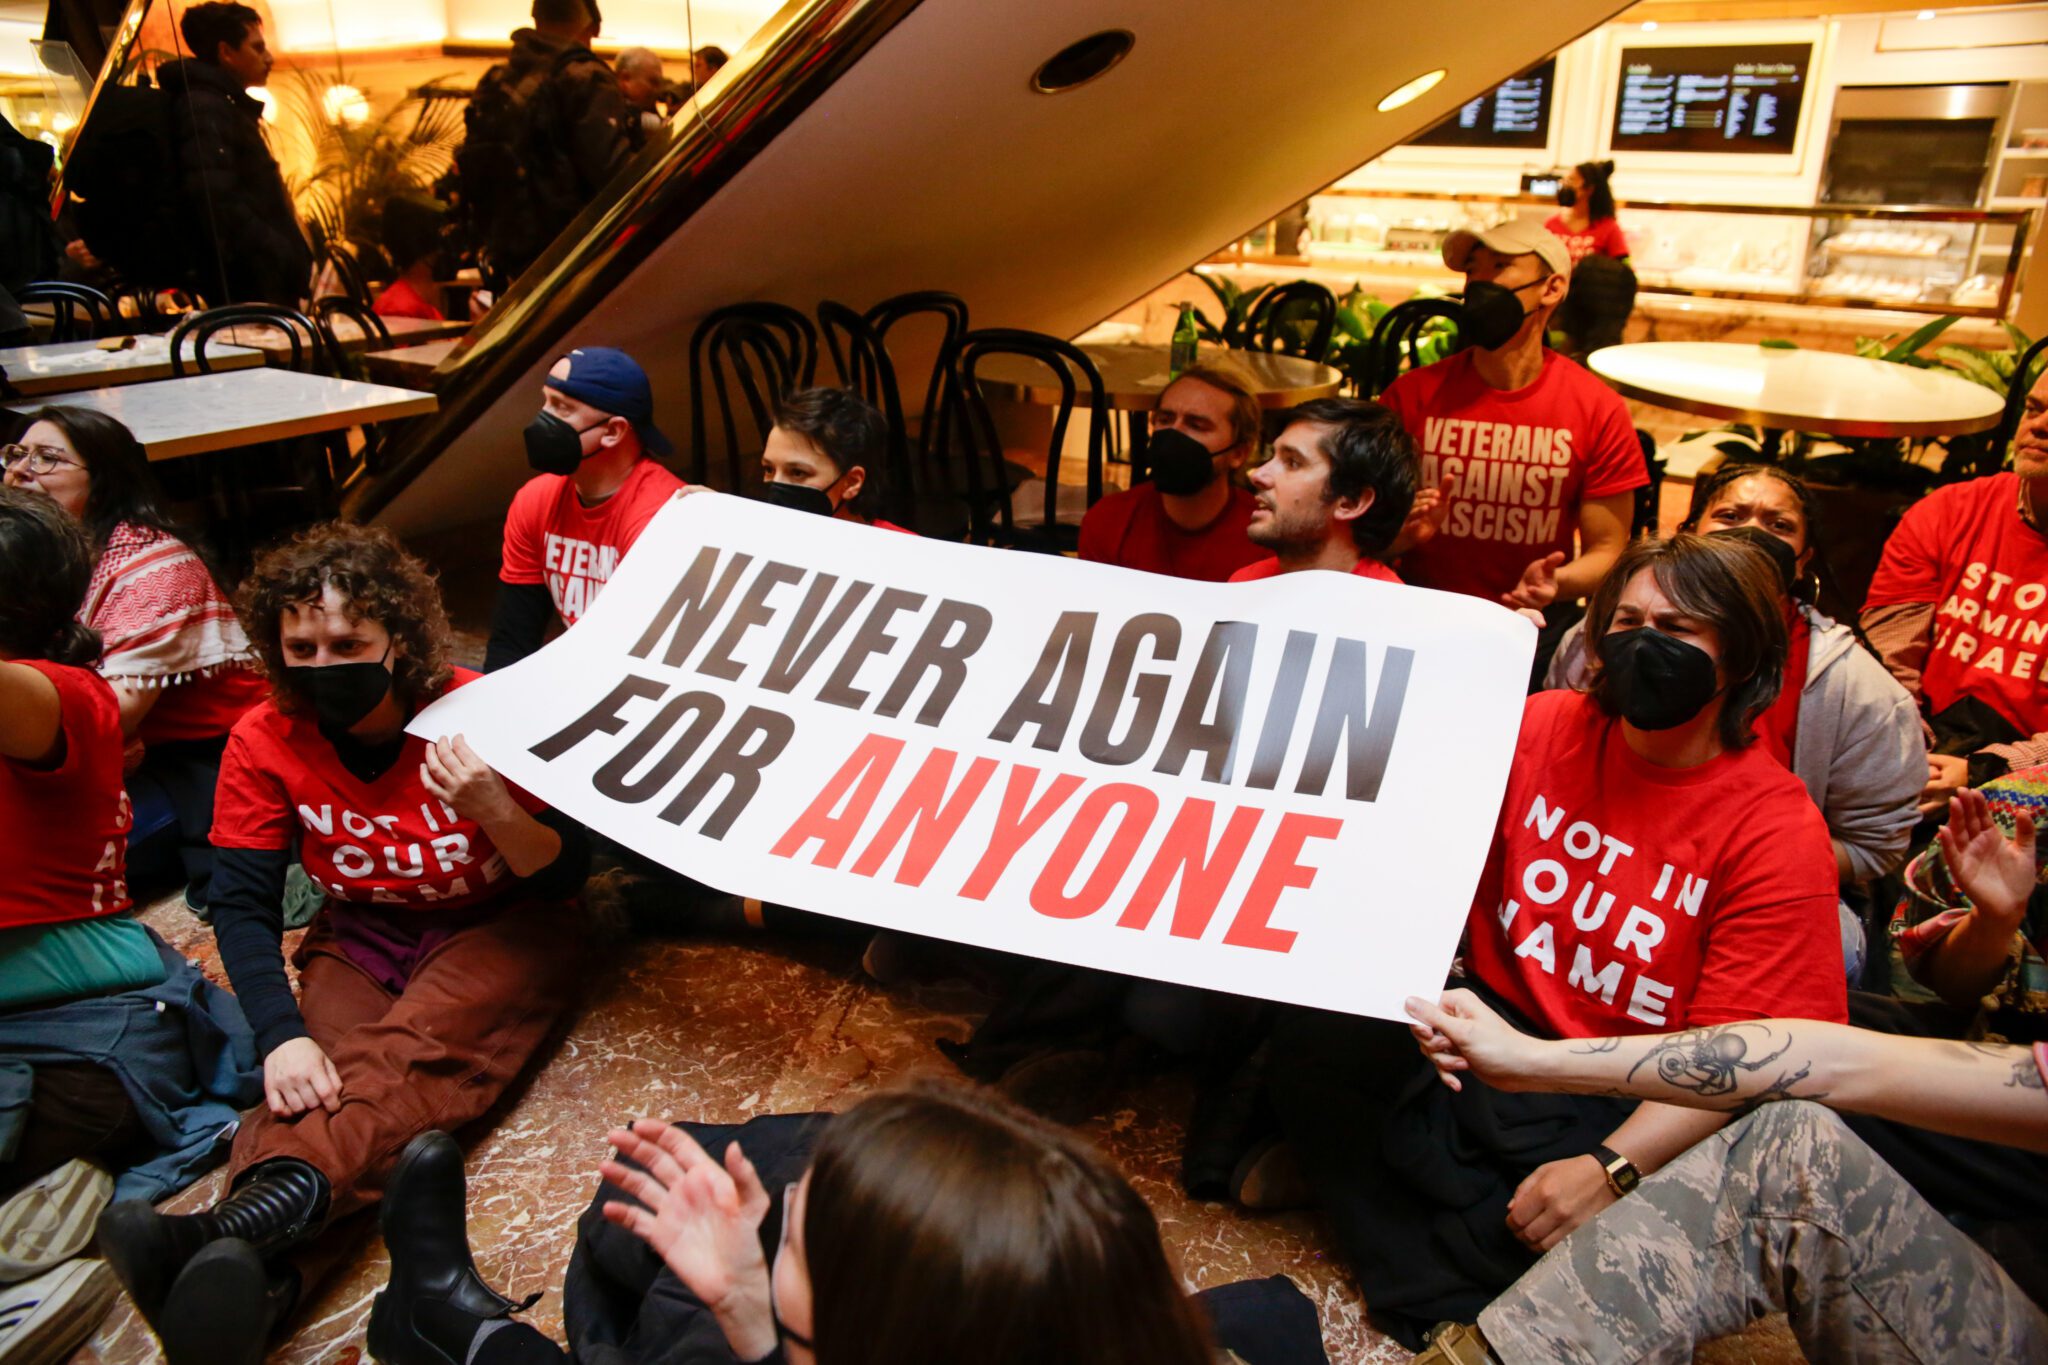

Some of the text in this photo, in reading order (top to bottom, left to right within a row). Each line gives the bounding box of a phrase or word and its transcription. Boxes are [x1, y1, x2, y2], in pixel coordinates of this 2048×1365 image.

[1424, 416, 1573, 466] VETERANS
[1421, 453, 1570, 508] AGAINST
[1440, 500, 1561, 546] SCISM
[1961, 562, 2047, 611] STO
[1937, 594, 2048, 645] ARMIN
[628, 546, 1415, 803] NEVER AGAIN
[298, 803, 400, 840] NOT
[527, 674, 1344, 954] FOR ANYONE
[332, 833, 475, 879] OUR
[1523, 793, 1709, 917] NOT IN
[1522, 858, 1666, 963] OUR
